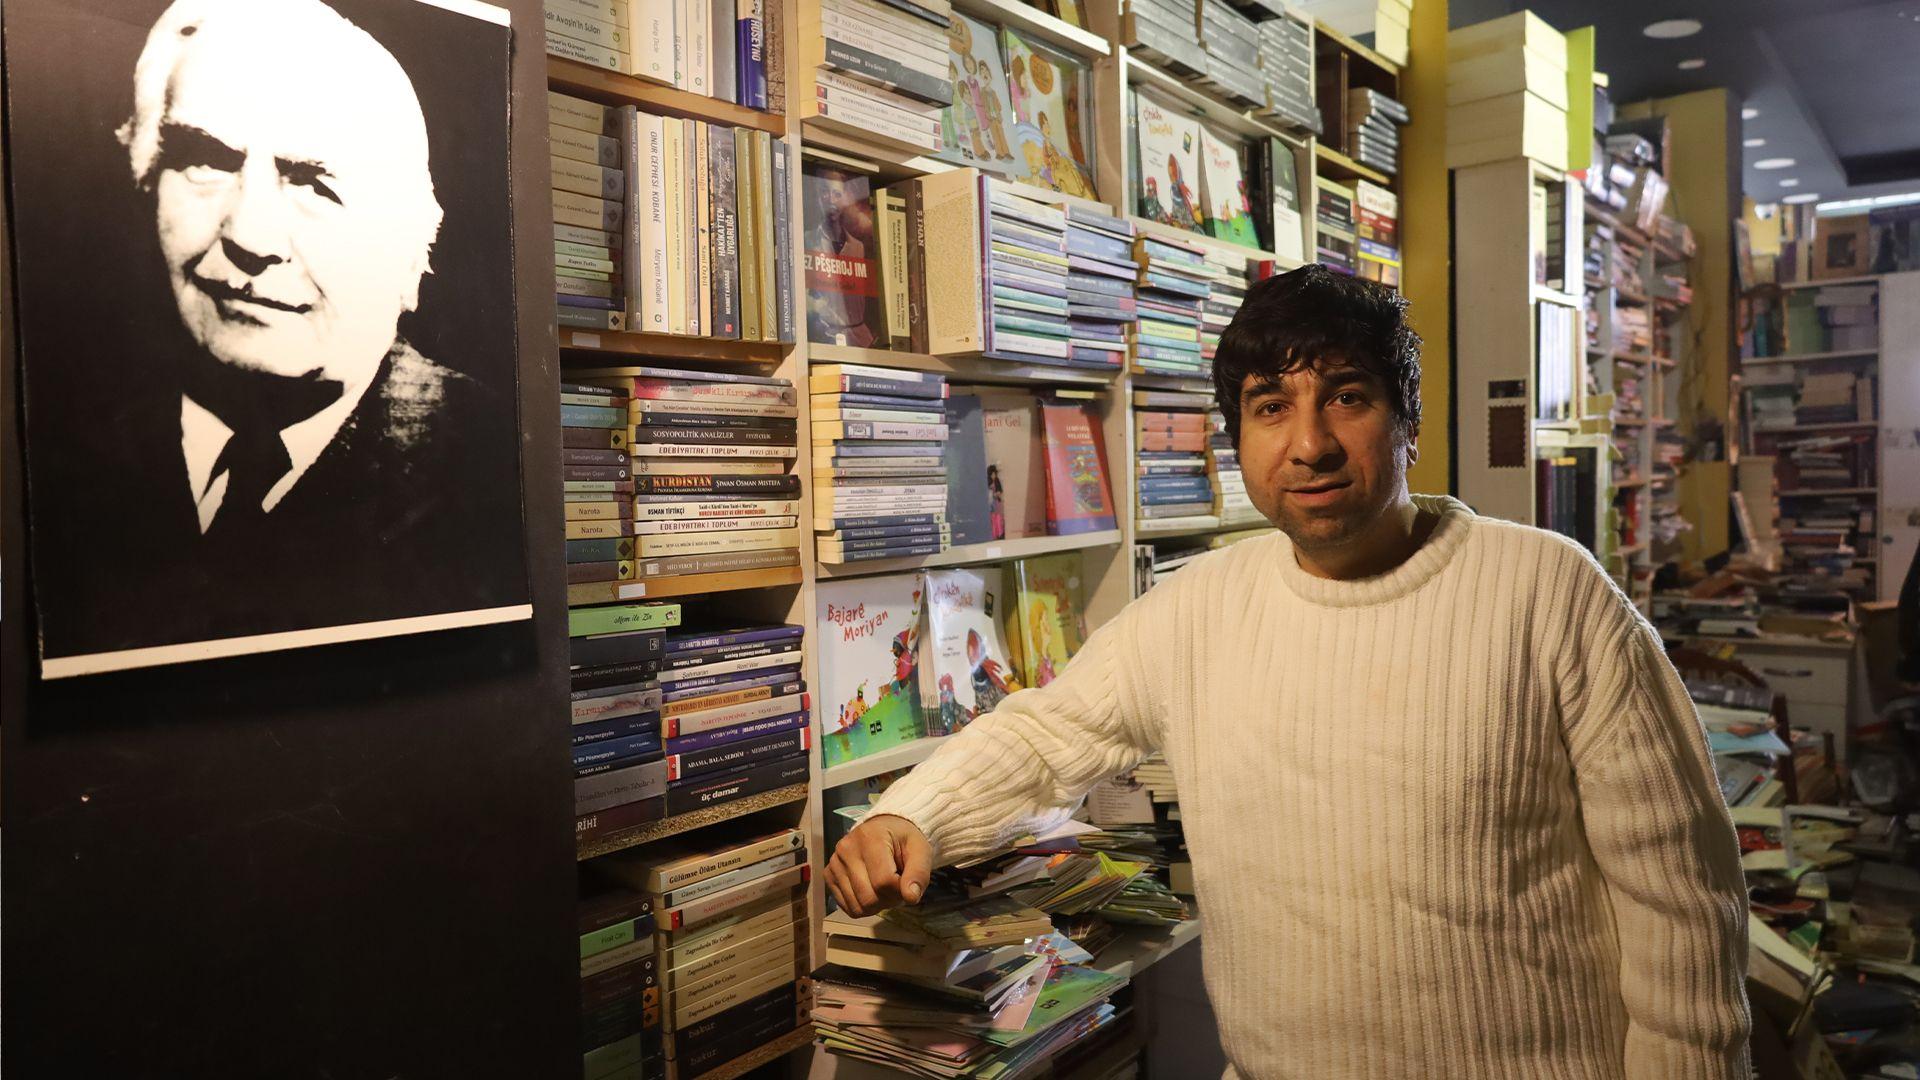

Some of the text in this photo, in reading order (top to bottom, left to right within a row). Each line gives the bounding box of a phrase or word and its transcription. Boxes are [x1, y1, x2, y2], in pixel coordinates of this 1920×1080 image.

[649, 131, 658, 154] ONUR
[815, 253, 853, 278] PÊŞEROJ
[855, 261, 868, 278] IM
[652, 430, 699, 439] SOSYOPOLİTİK
[699, 430, 735, 440] ANALİZLER
[711, 446, 738, 455] TOPLUM
[647, 508, 665, 516] OSMAN
[712, 520, 739, 529] TOPLUM
[827, 601, 865, 627] Bajarê
[843, 610, 889, 642] Moriyan
[701, 786, 740, 803] üç damar
[577, 815, 597, 831] RİHİ
